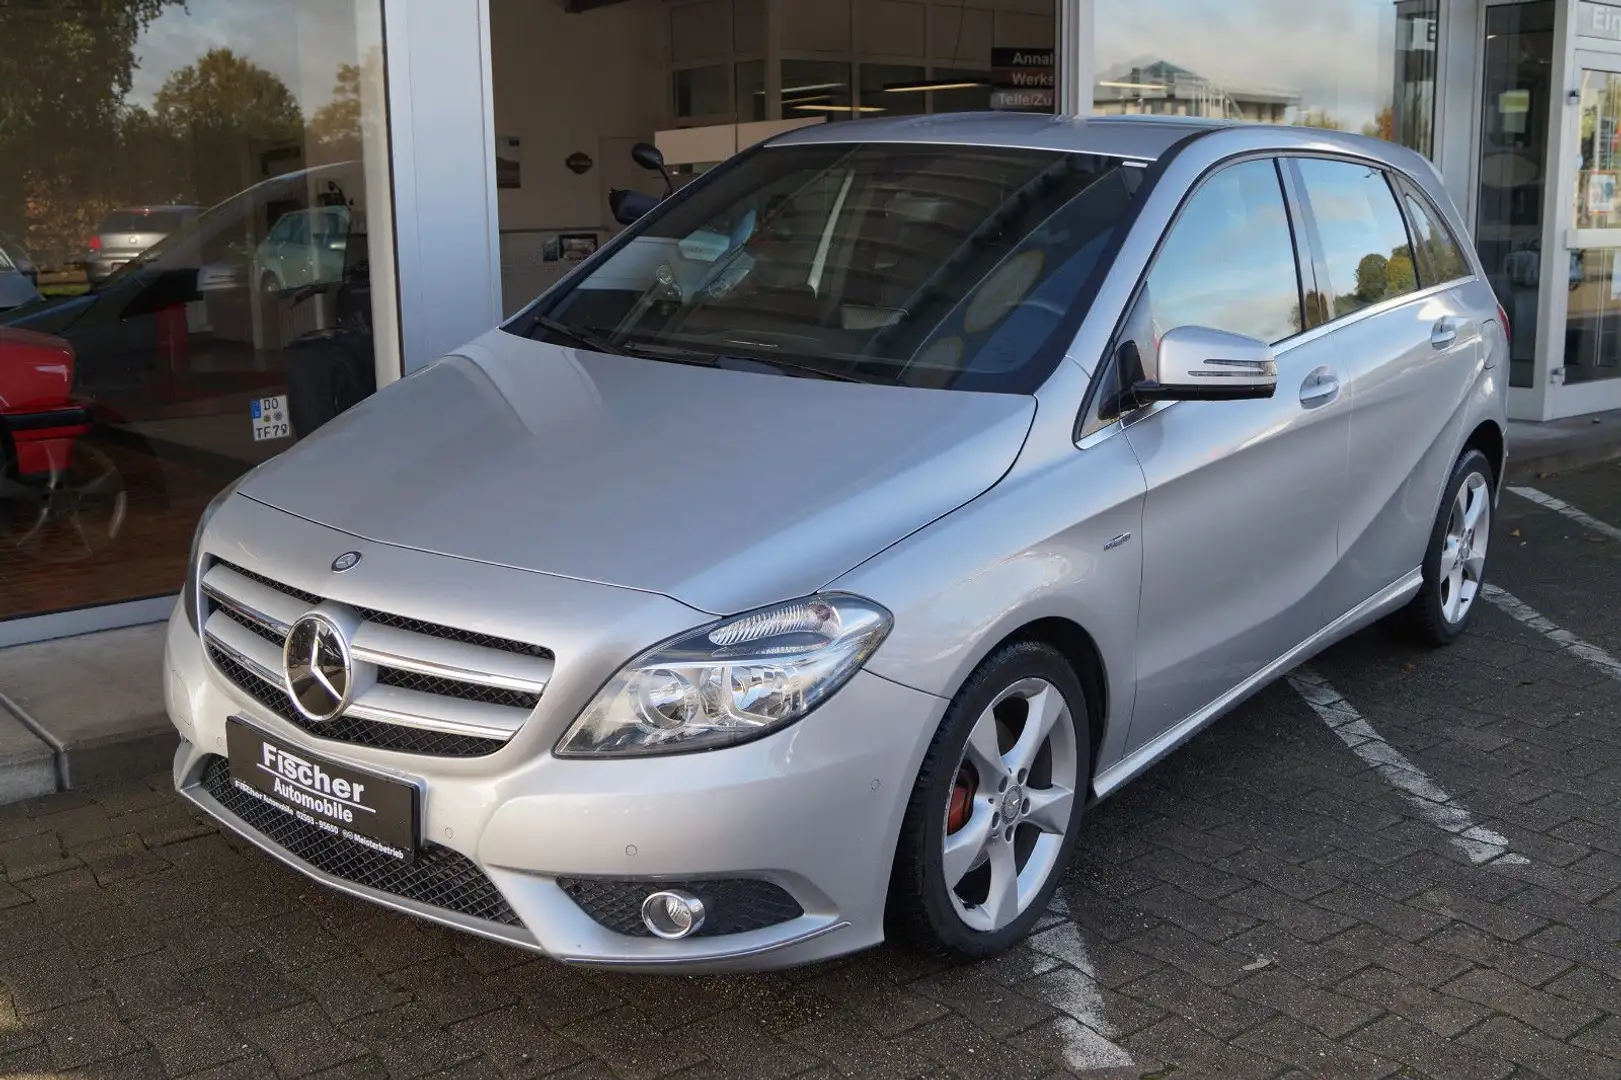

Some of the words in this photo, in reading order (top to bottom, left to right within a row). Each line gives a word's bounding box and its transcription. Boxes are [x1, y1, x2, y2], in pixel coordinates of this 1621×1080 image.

[263, 398, 279, 411] DO
[262, 742, 364, 803] Fischer
[274, 777, 353, 823] Automobile
[353, 833, 404, 860] Meisterbetrieb
